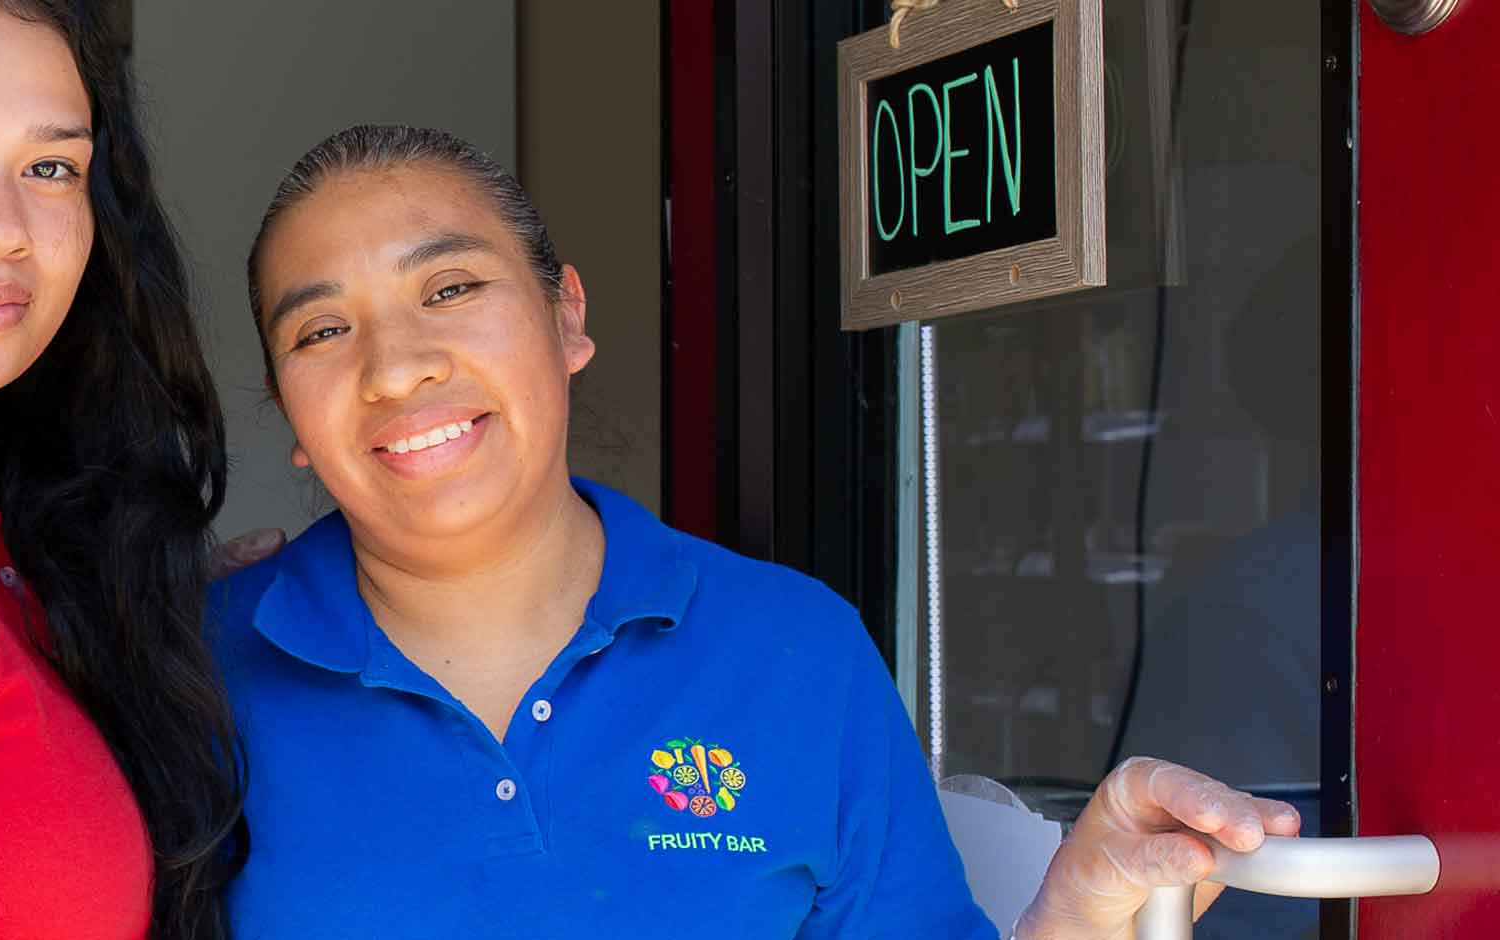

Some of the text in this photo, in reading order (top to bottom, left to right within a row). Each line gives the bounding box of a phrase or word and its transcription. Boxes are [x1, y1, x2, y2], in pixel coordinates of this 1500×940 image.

[873, 58, 1021, 241] OPEN
[648, 832, 767, 852] FRUITY BAR
